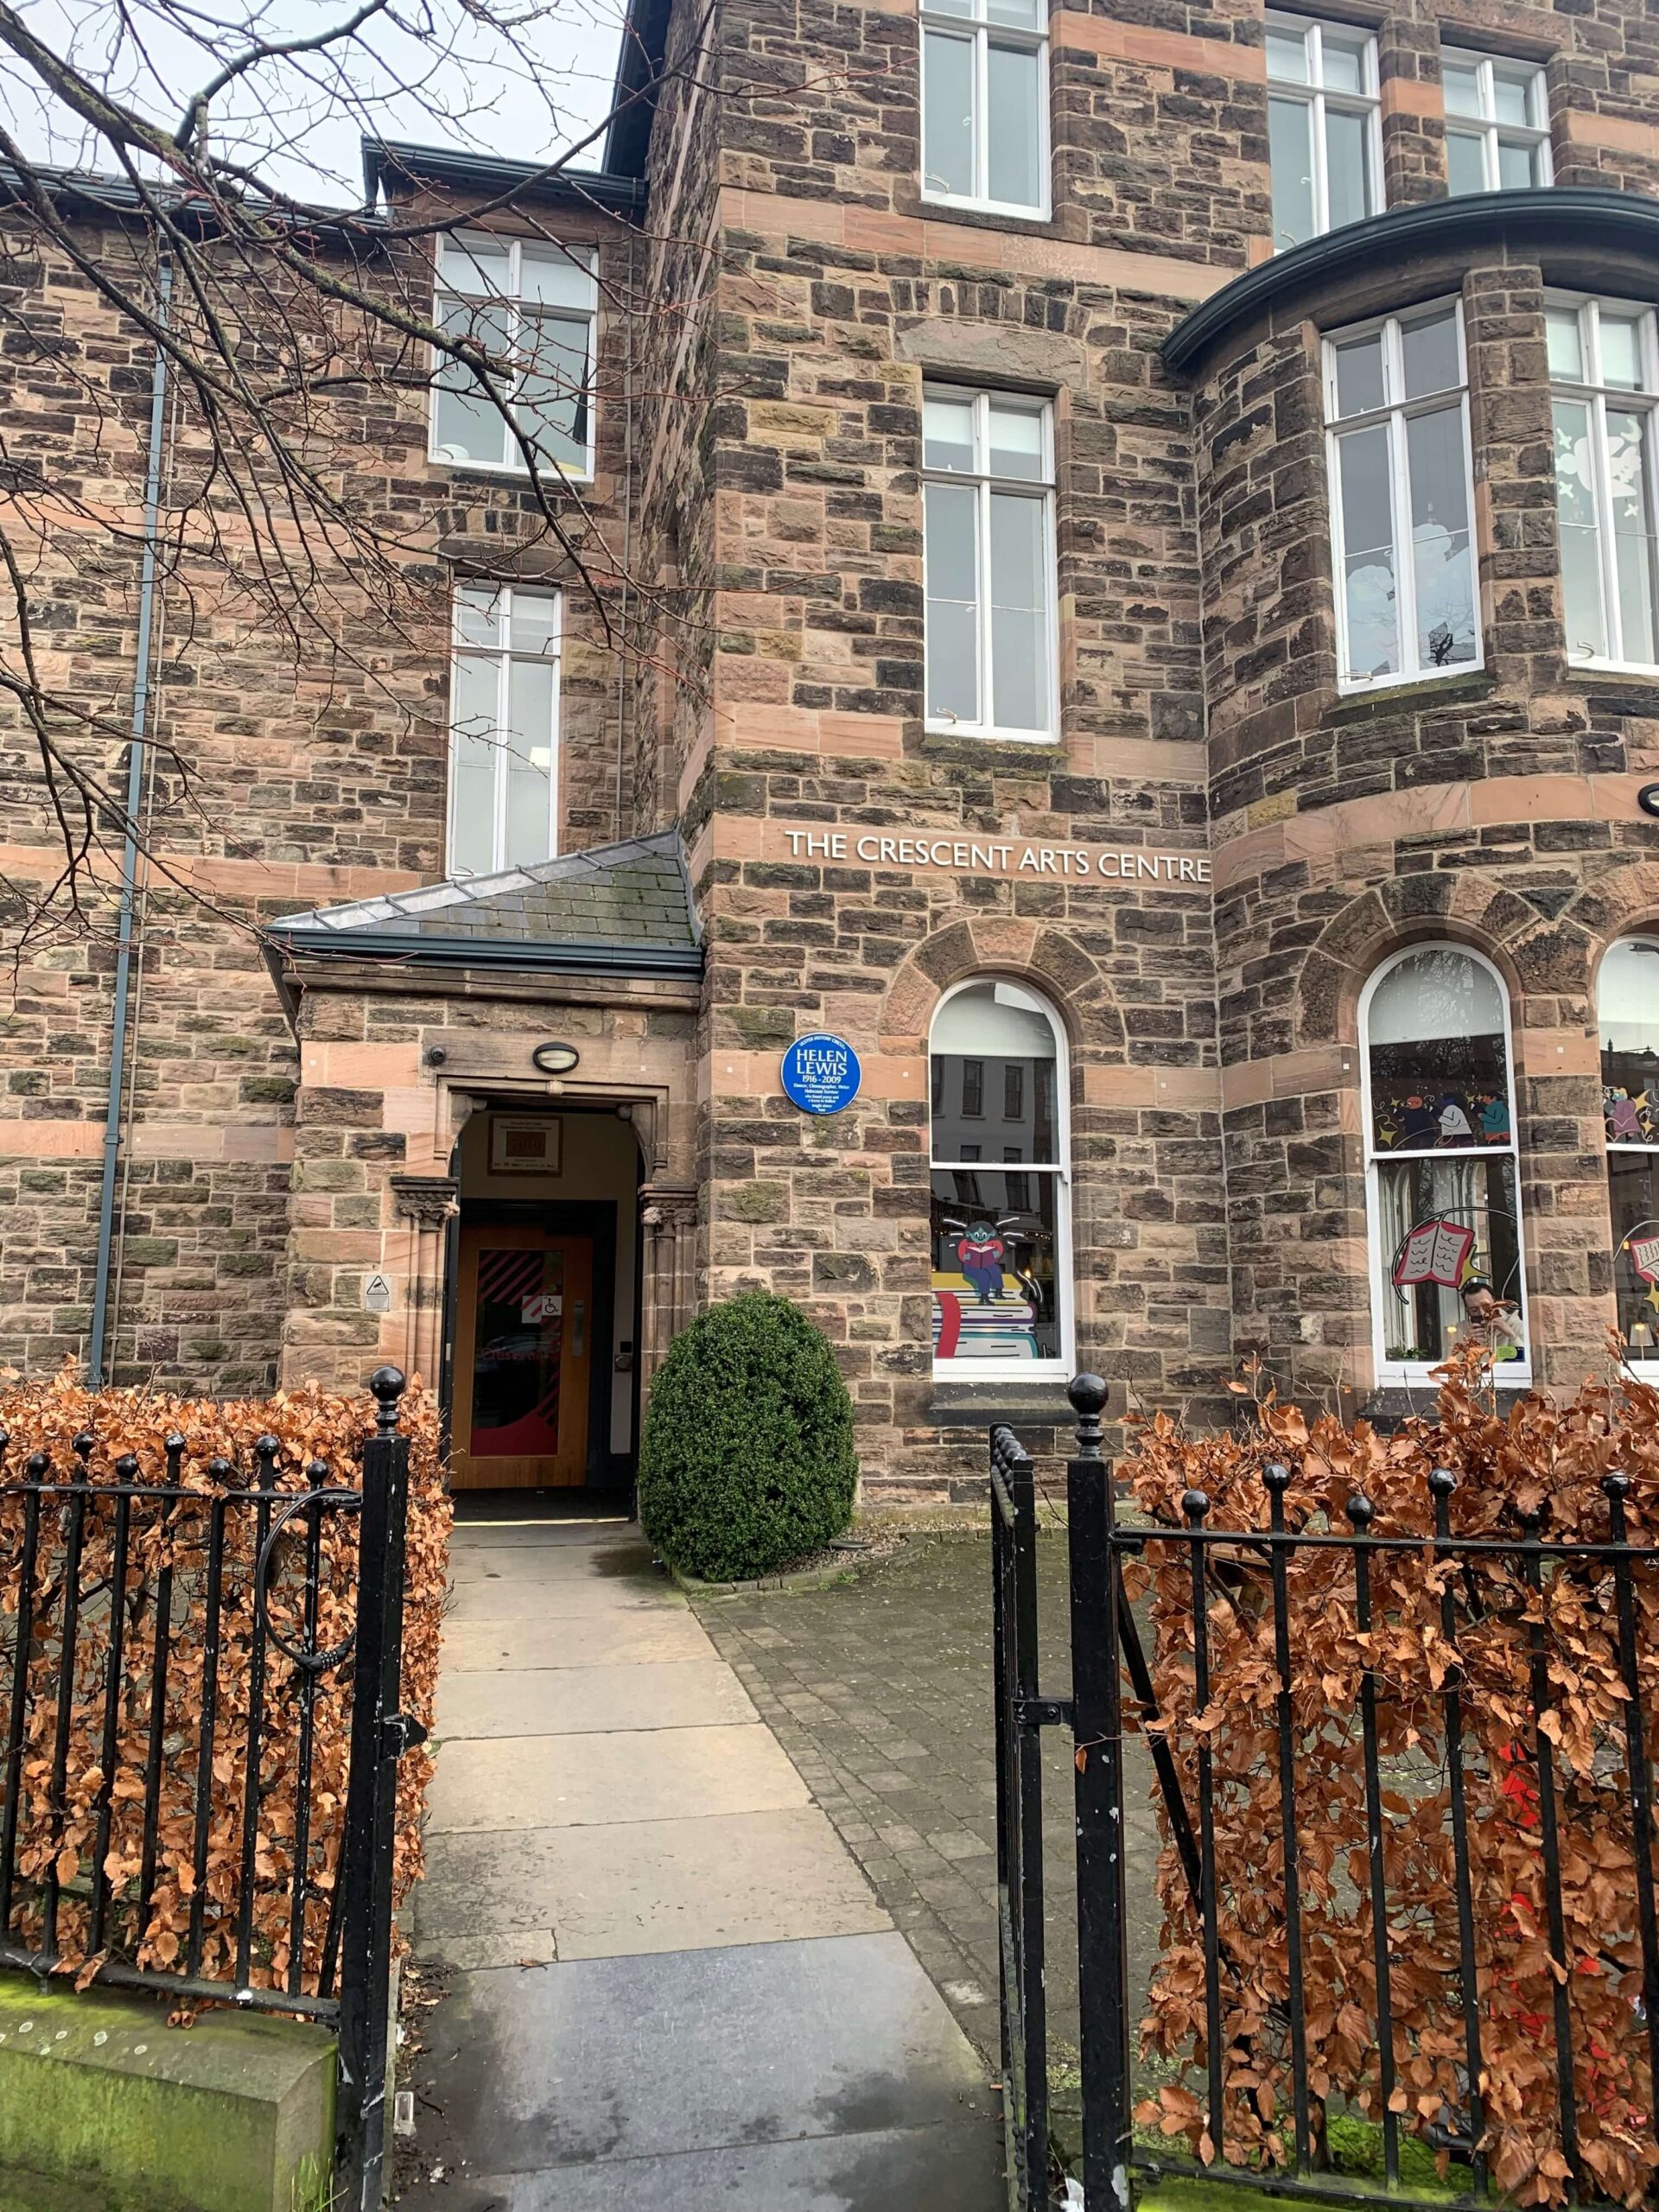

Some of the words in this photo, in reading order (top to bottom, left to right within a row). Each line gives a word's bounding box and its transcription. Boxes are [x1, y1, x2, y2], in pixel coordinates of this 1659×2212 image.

[785, 830, 847, 859] THE
[856, 836, 1014, 870] CRESCENT
[1018, 847, 1090, 874] ARTS
[1098, 853, 1211, 882] CENTRE
[797, 1048, 847, 1063] HELEN
[797, 1061, 848, 1076] LEWIS
